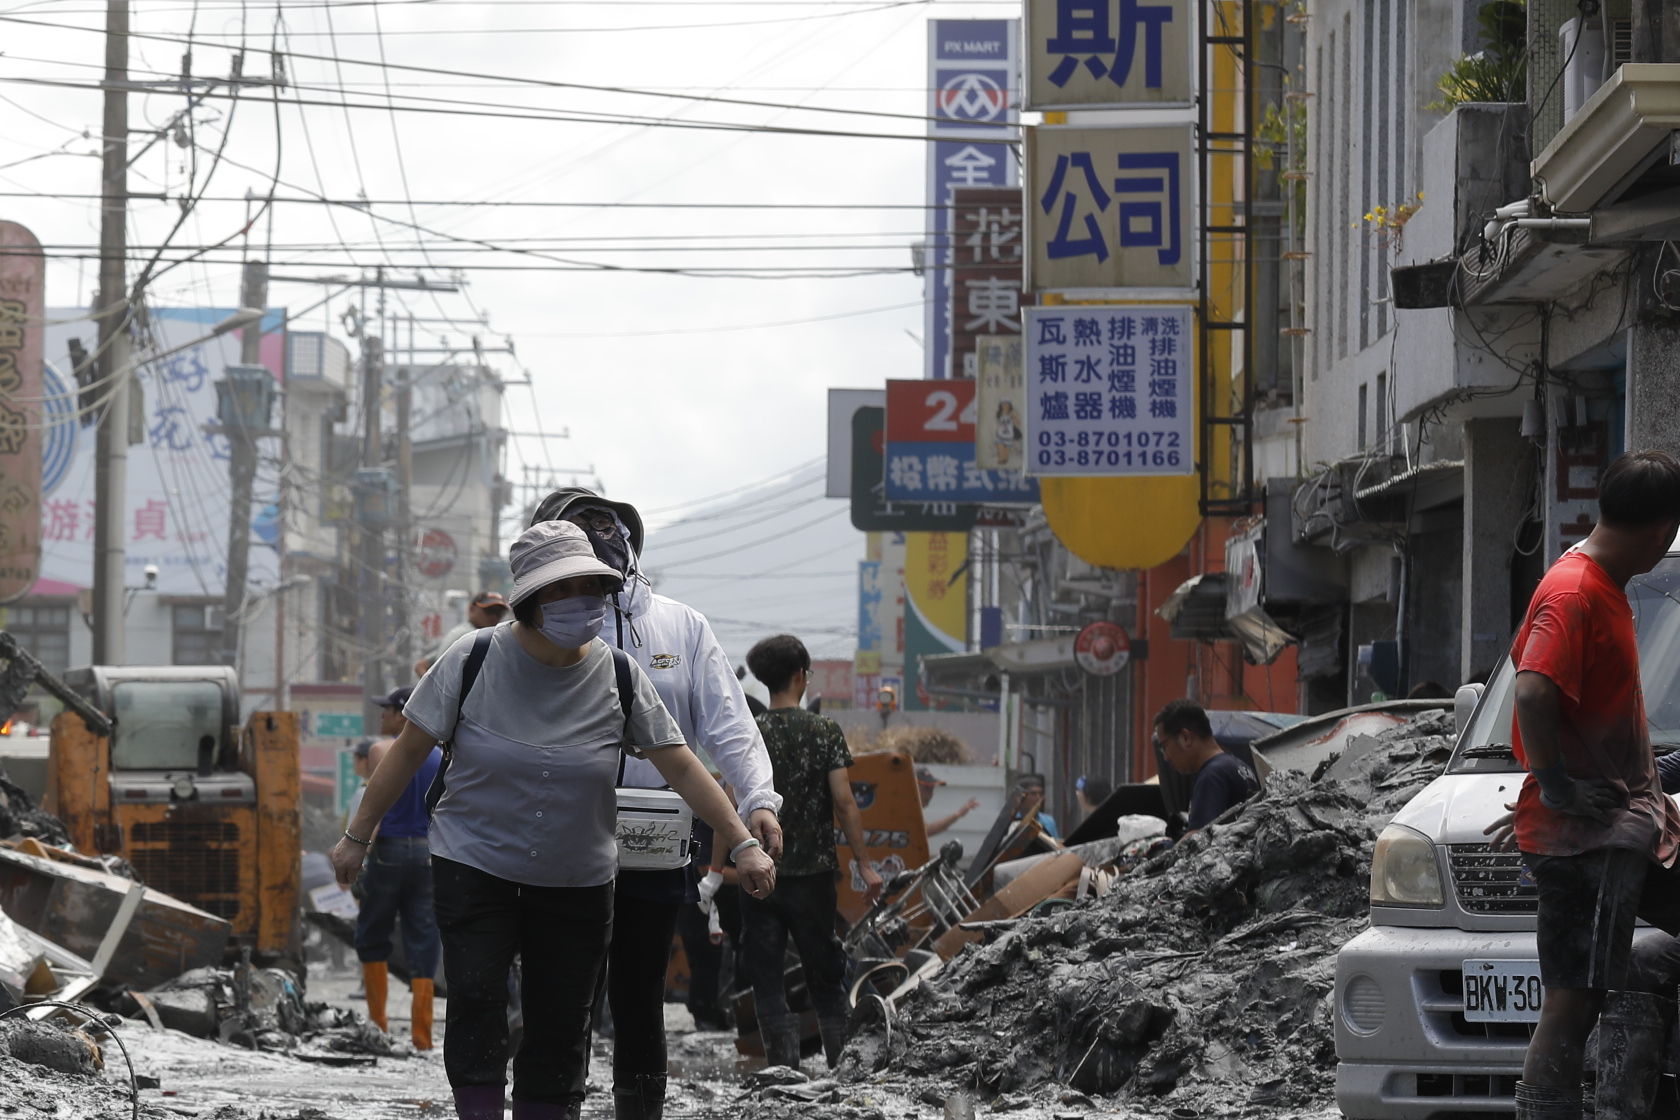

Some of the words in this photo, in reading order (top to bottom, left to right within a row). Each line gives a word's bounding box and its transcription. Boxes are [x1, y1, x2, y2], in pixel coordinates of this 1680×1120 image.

[944, 40, 962, 52] PX
[963, 40, 1001, 52] MART
[1047, 0, 1174, 88] 斯
[1041, 152, 1181, 266] 公司
[1141, 316, 1180, 336] 清洗
[1037, 317, 1069, 421] 瓦斯爐
[1073, 317, 1103, 420] 熱水器
[1107, 316, 1137, 420] 排油煙機
[1149, 337, 1177, 419] 排油煙機
[1038, 431, 1180, 448] 03-8701072
[1038, 450, 1180, 467] 03-8701166
[42, 498, 170, 541] 游貞
